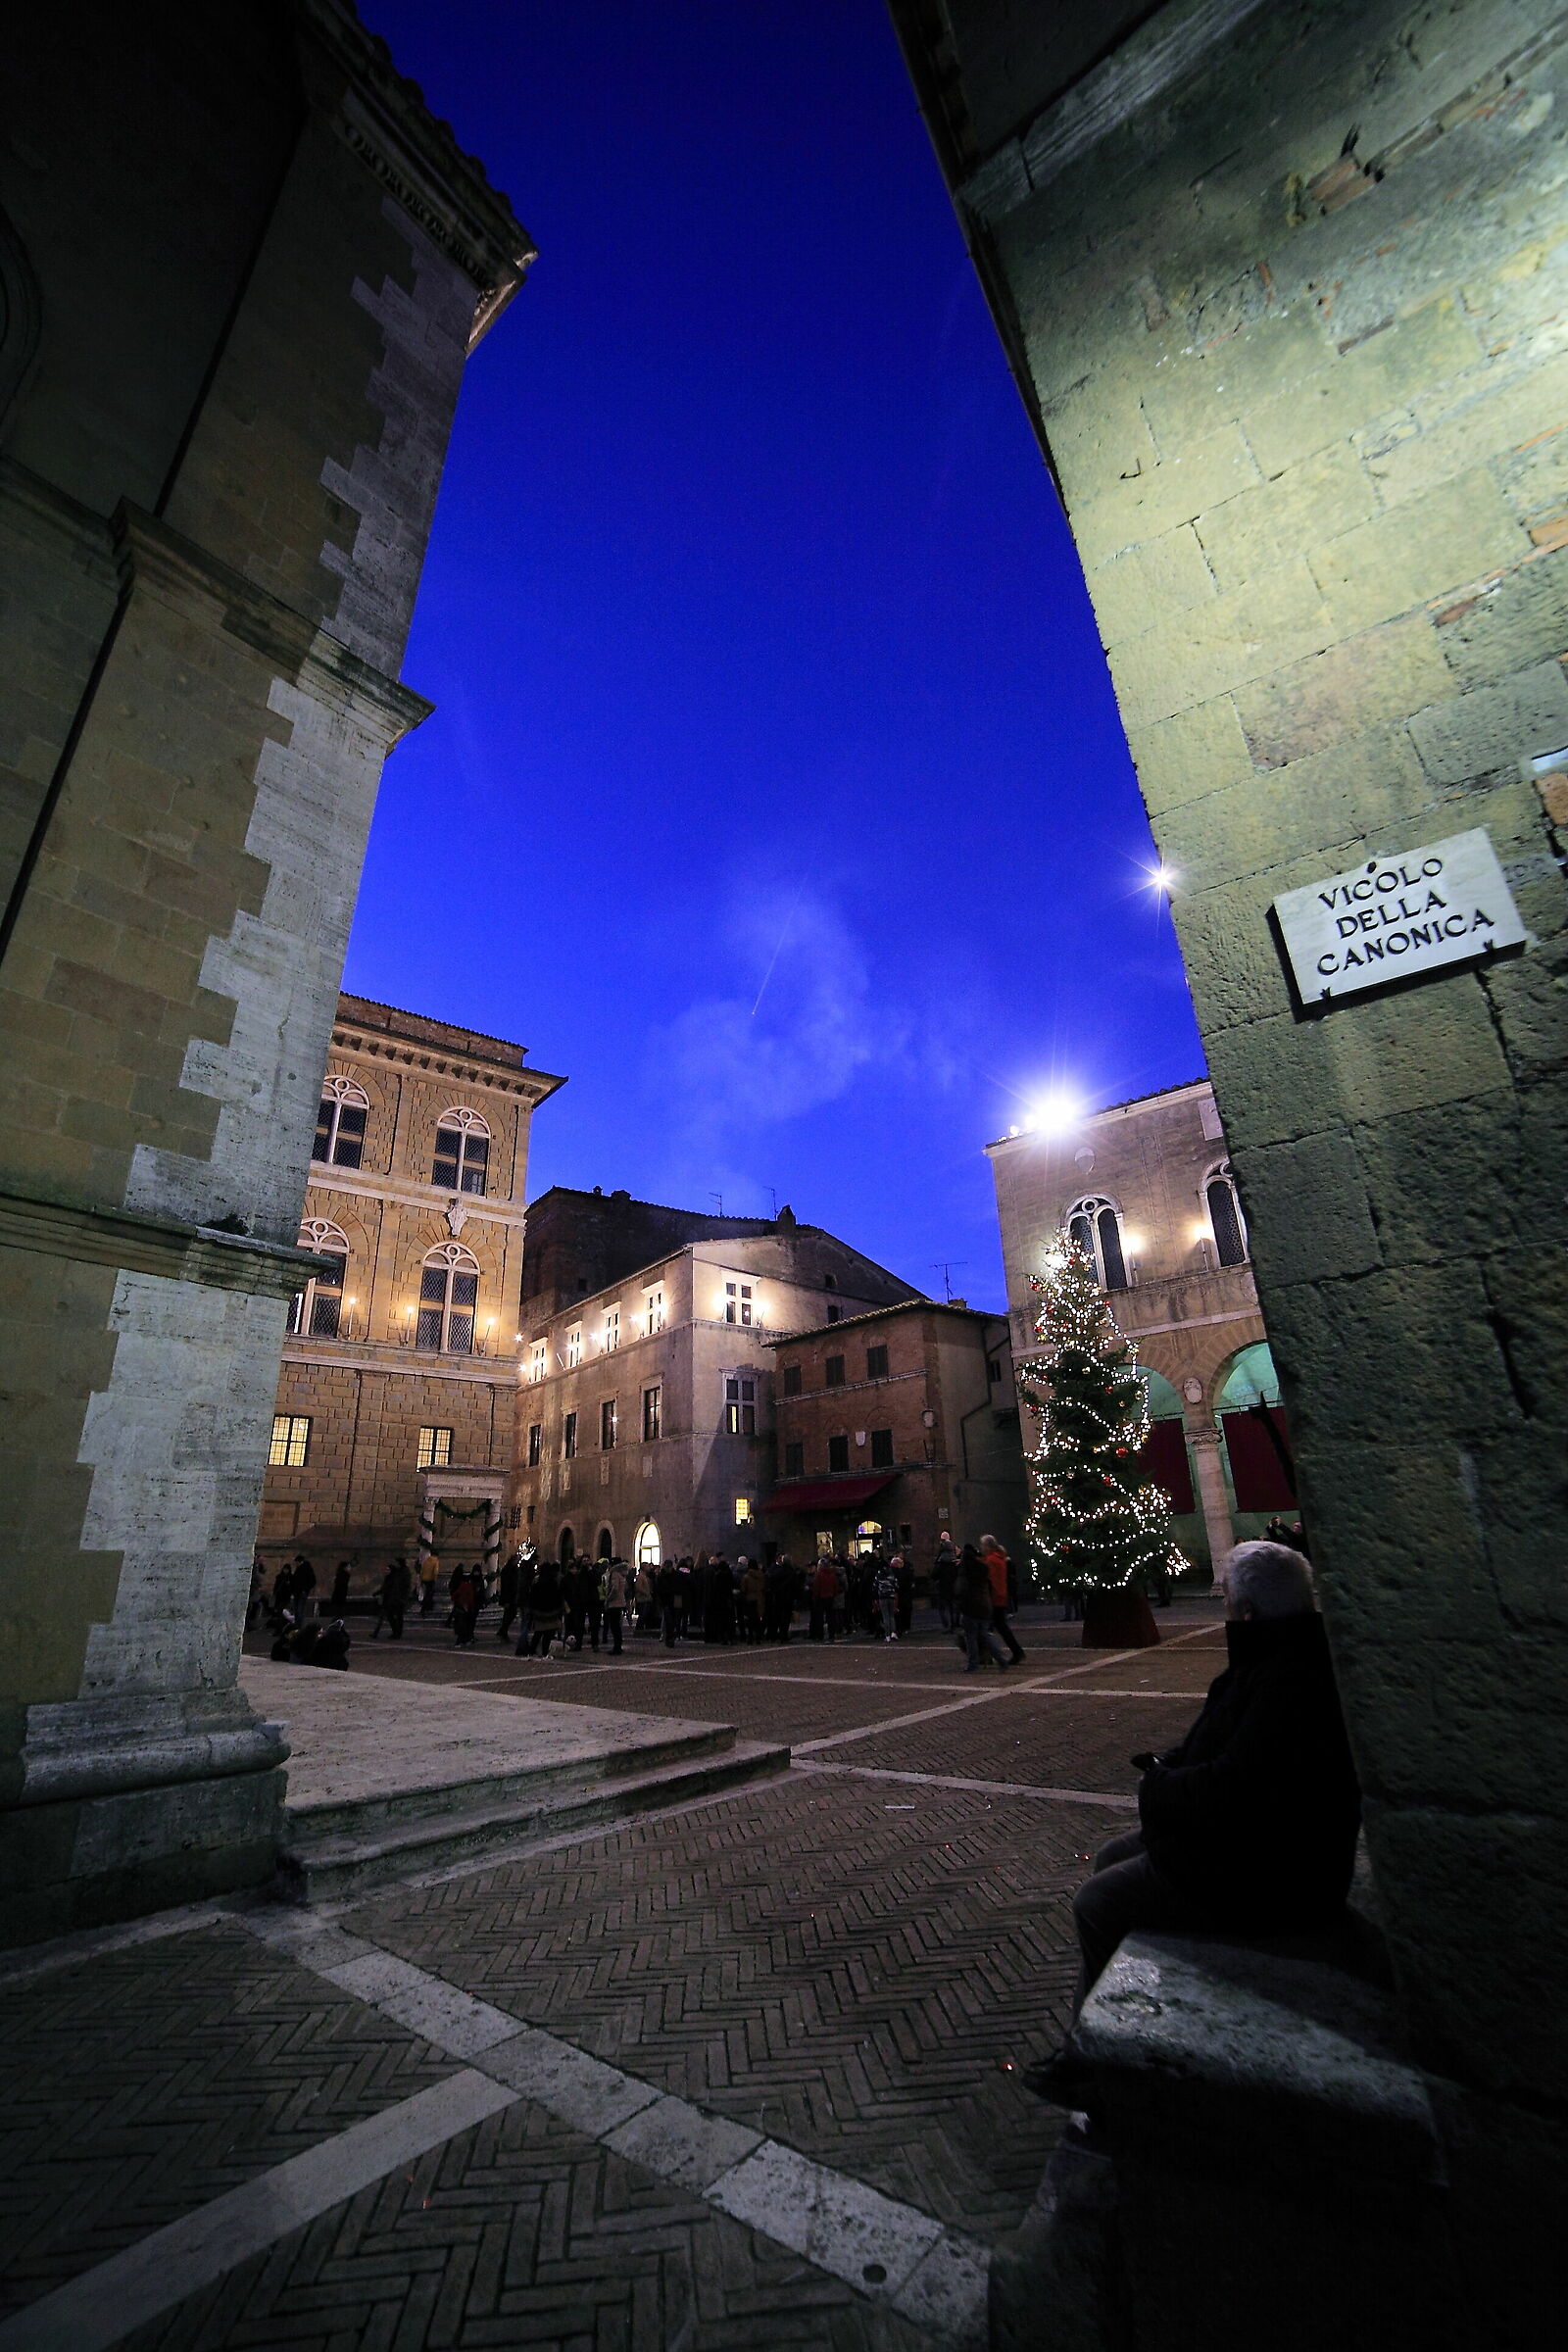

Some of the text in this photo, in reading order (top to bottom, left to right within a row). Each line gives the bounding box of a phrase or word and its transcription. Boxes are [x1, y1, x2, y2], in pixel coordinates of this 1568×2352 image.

[1318, 858, 1443, 909] VICOLO
[1336, 891, 1446, 938] DELLA
[1317, 909, 1494, 975] CANONICA
